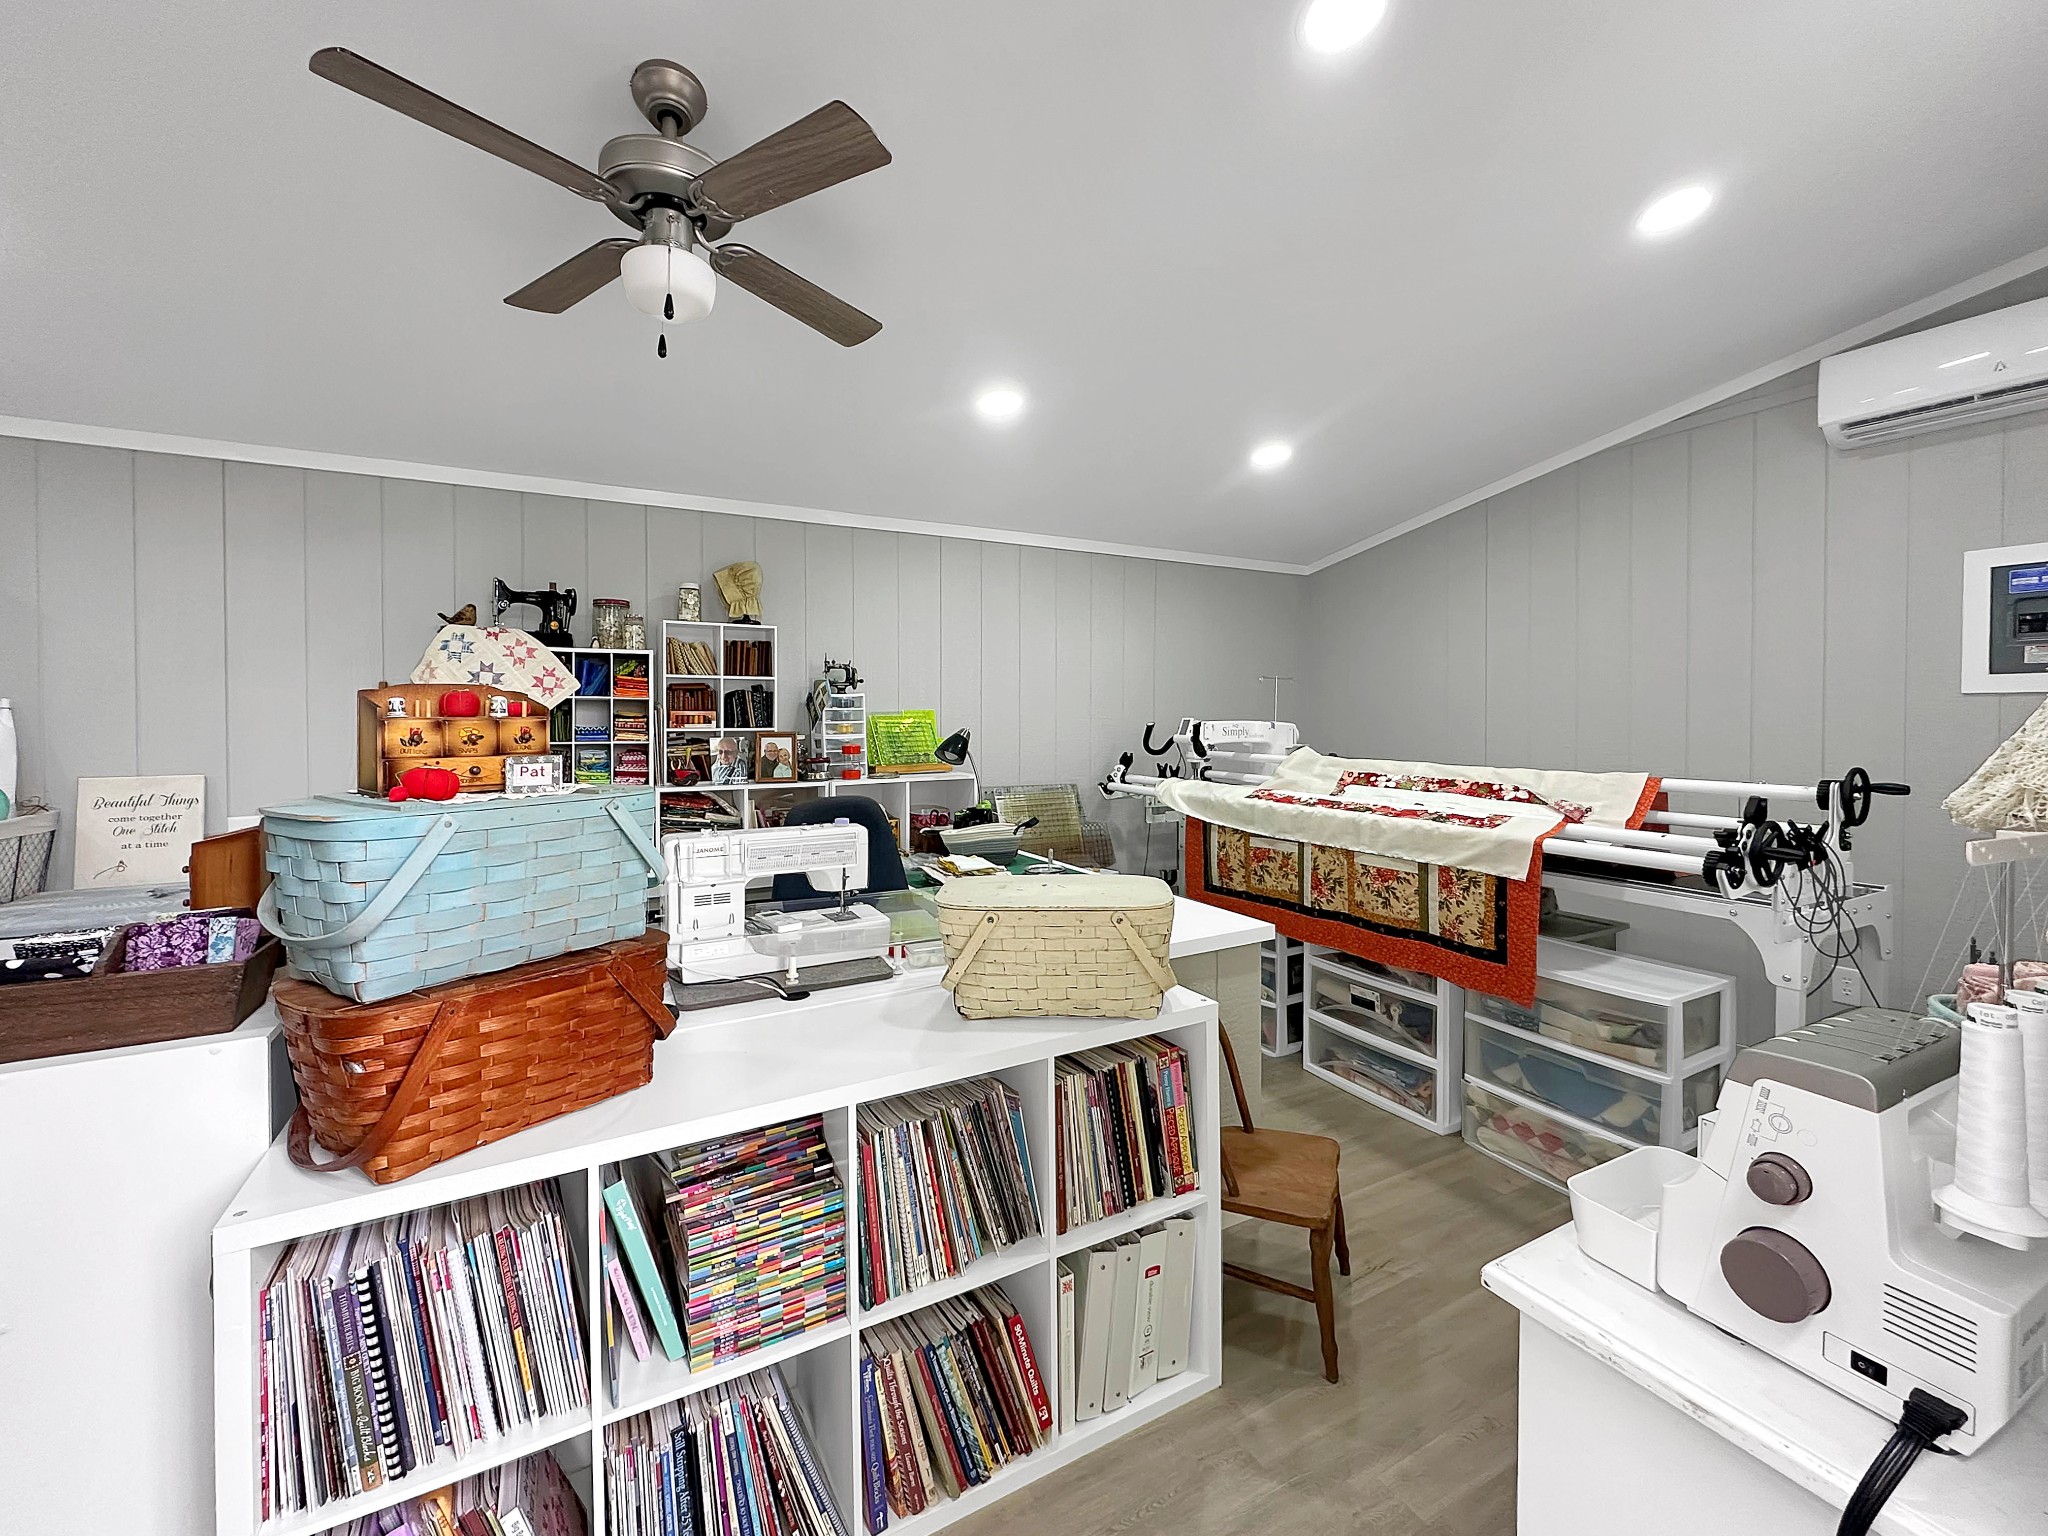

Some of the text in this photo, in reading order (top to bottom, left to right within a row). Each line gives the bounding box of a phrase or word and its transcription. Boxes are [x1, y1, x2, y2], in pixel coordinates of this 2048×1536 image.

[1222, 727, 1250, 739] Simply
[400, 748, 428, 756] BUTTONS
[520, 766, 546, 777] Pat
[92, 792, 199, 813] Beautiful Things
[108, 812, 183, 823] come together
[112, 821, 177, 837] One Stitch
[121, 842, 132, 850] at
[1162, 1070, 1170, 1087] Penny
[1166, 1107, 1176, 1136] PIECED
[1176, 1106, 1186, 1134] PIECED
[500, 1258, 510, 1272] YOUR
[503, 1271, 514, 1292] PERFECT
[506, 1290, 518, 1313] QUILTING
[337, 1291, 356, 1353] THIMBLEBERRIES
[882, 1357, 895, 1381] Quilts
[1012, 1322, 1041, 1396] 90-Minute Quilts
[349, 1368, 361, 1385] BIG
[352, 1383, 365, 1409] BOOK
[884, 1378, 901, 1409] Through
[894, 1407, 904, 1420] the
[355, 1414, 371, 1436] Quilt
[896, 1418, 909, 1445] Seasons
[360, 1434, 376, 1461] Blocks
[673, 1430, 685, 1450] Still
[674, 1448, 688, 1493] Stripping
[869, 1461, 880, 1482] Quilt
[678, 1490, 690, 1513] After
[872, 1480, 882, 1504] Blocks
[679, 1512, 692, 1525] 25
